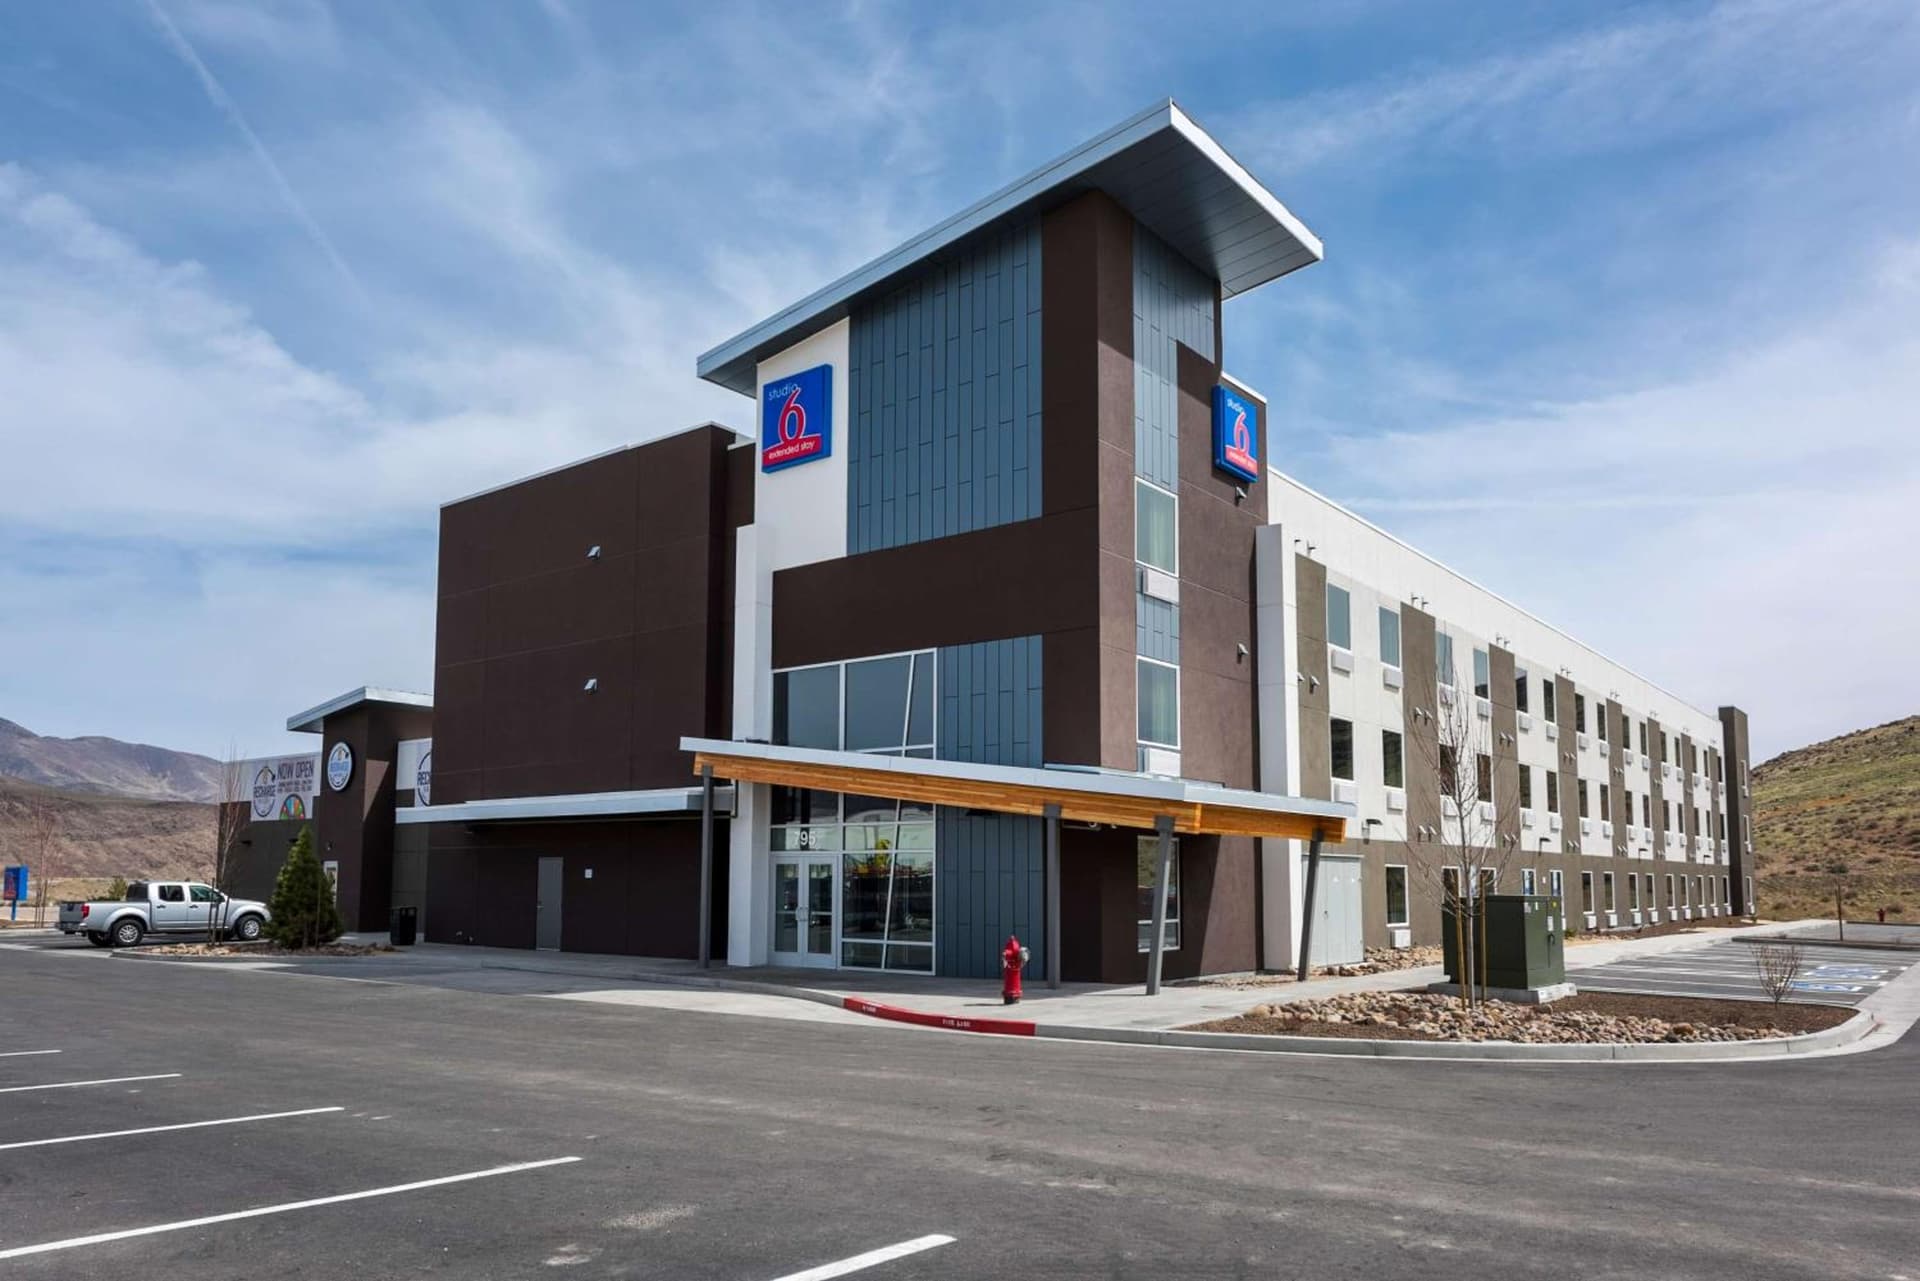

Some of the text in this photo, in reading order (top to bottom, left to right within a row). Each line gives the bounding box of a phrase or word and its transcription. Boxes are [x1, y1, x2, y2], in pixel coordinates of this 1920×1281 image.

[768, 384, 799, 400] studio
[778, 387, 807, 441] 6
[1234, 413, 1250, 452] 6
[768, 439, 815, 459] extended stay
[278, 760, 314, 779] NOW OPEN
